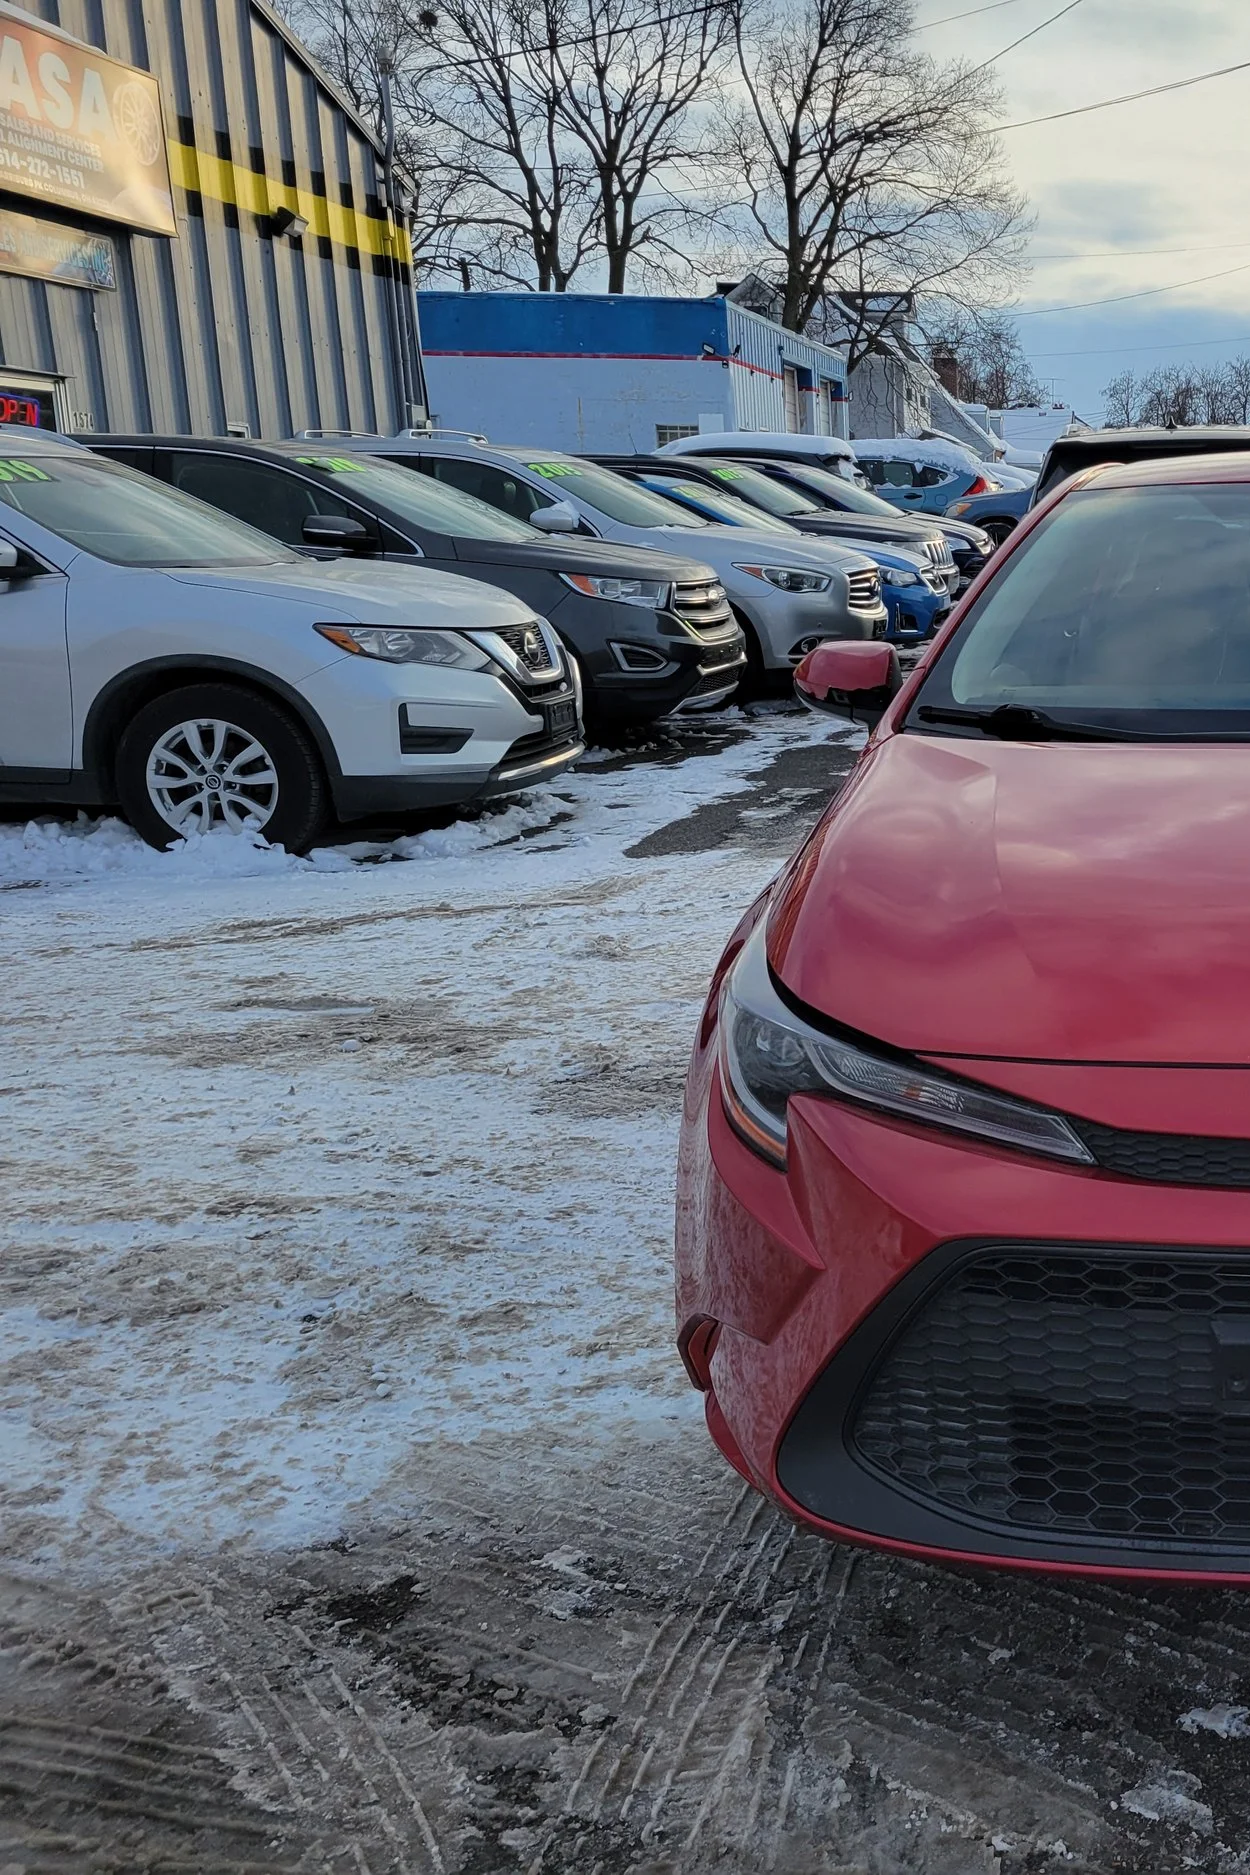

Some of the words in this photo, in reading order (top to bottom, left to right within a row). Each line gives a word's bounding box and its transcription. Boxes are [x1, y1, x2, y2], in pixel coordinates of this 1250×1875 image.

[0, 111, 31, 134] SALES
[32, 124, 54, 141] AND
[55, 131, 102, 157] SERVICES
[8, 131, 66, 161] ALIGNMENT
[67, 149, 105, 173] CENTER
[0, 398, 38, 427] OPEN
